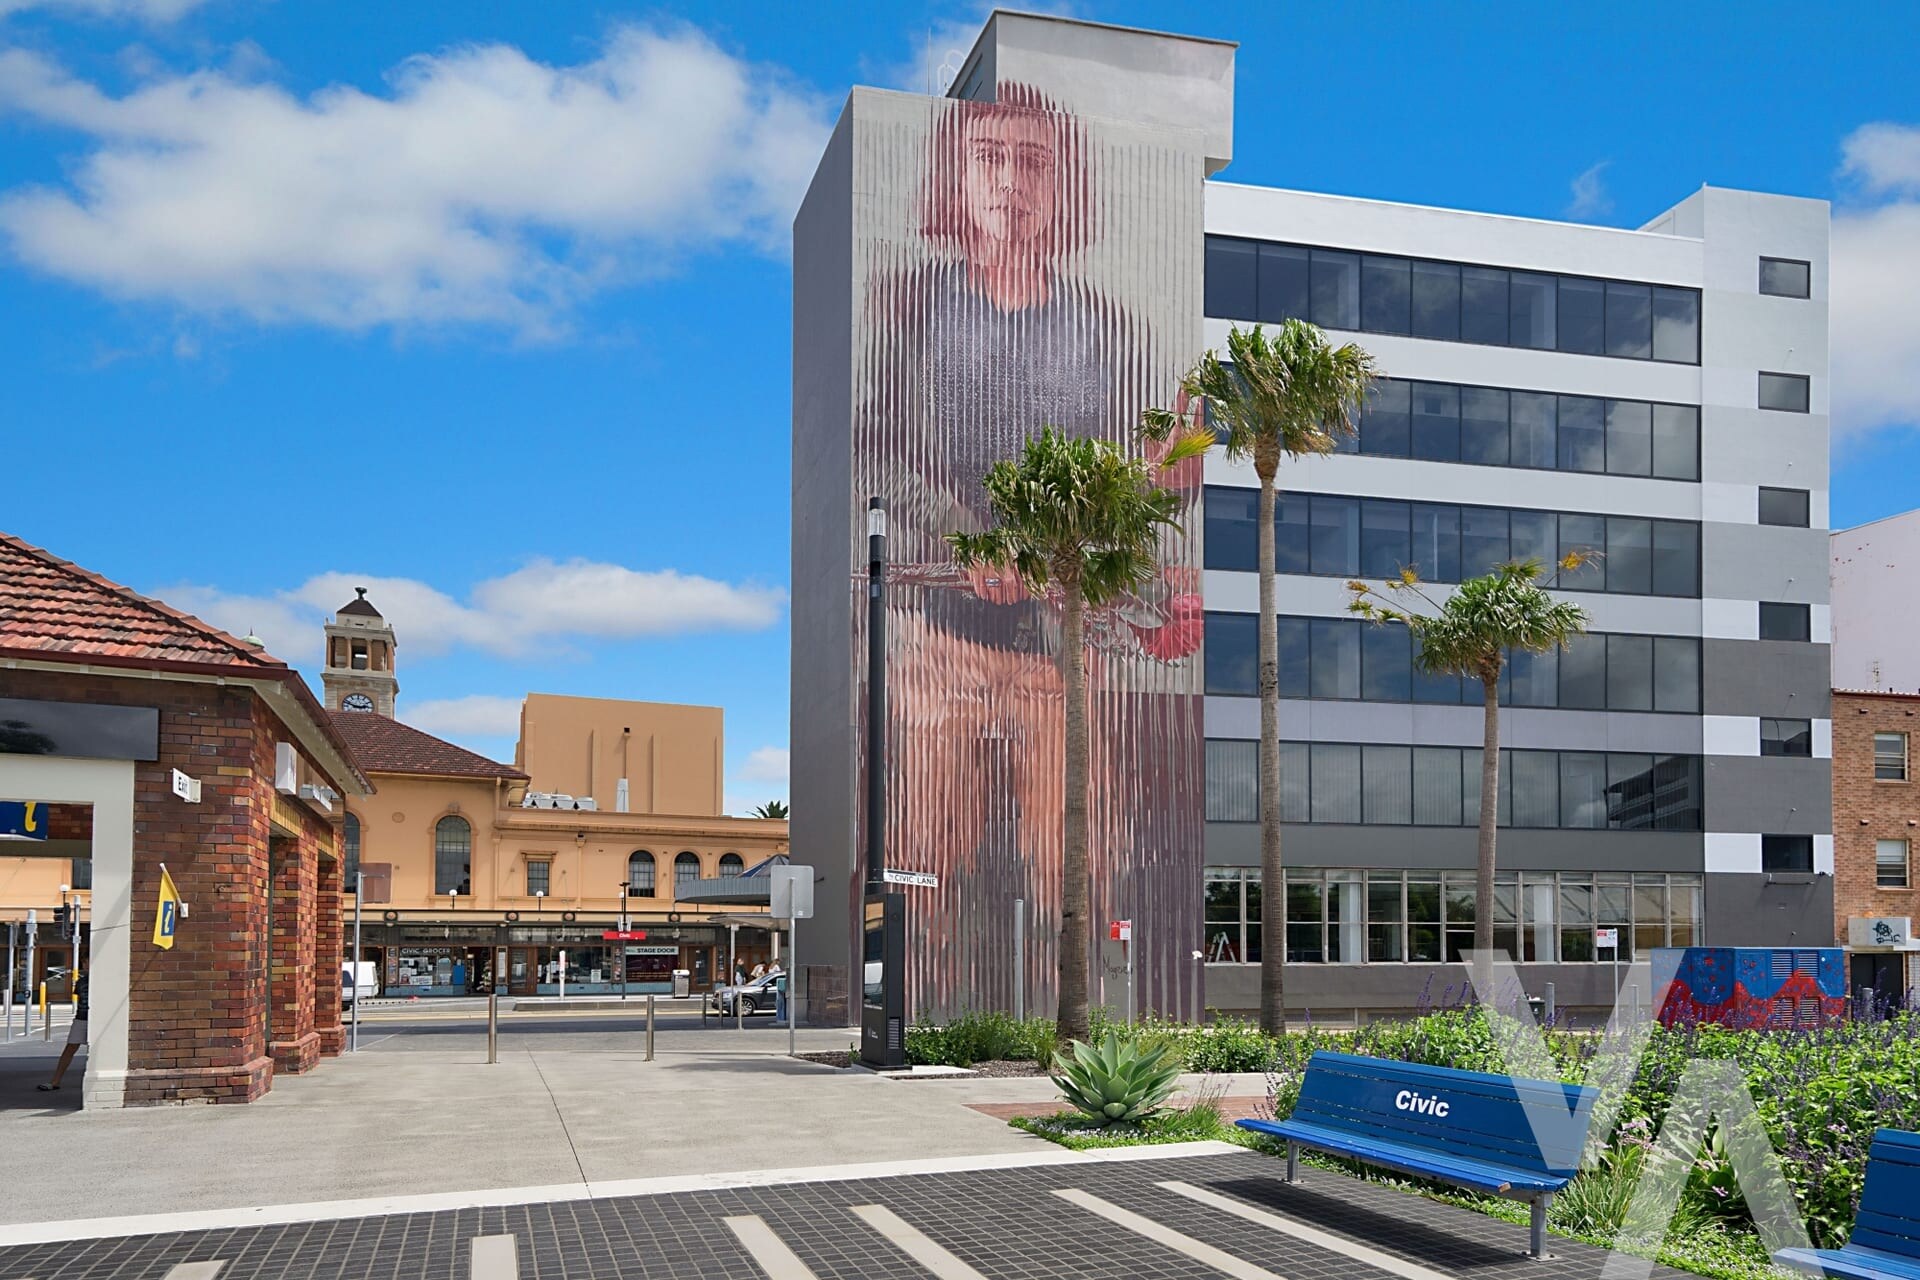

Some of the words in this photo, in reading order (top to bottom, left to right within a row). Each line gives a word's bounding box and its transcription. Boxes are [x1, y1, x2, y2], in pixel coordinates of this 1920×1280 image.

[178, 776, 188, 795] Exit
[895, 874, 914, 883] CIVIC
[917, 877, 937, 886] LANE
[1395, 1090, 1450, 1118] Civic
